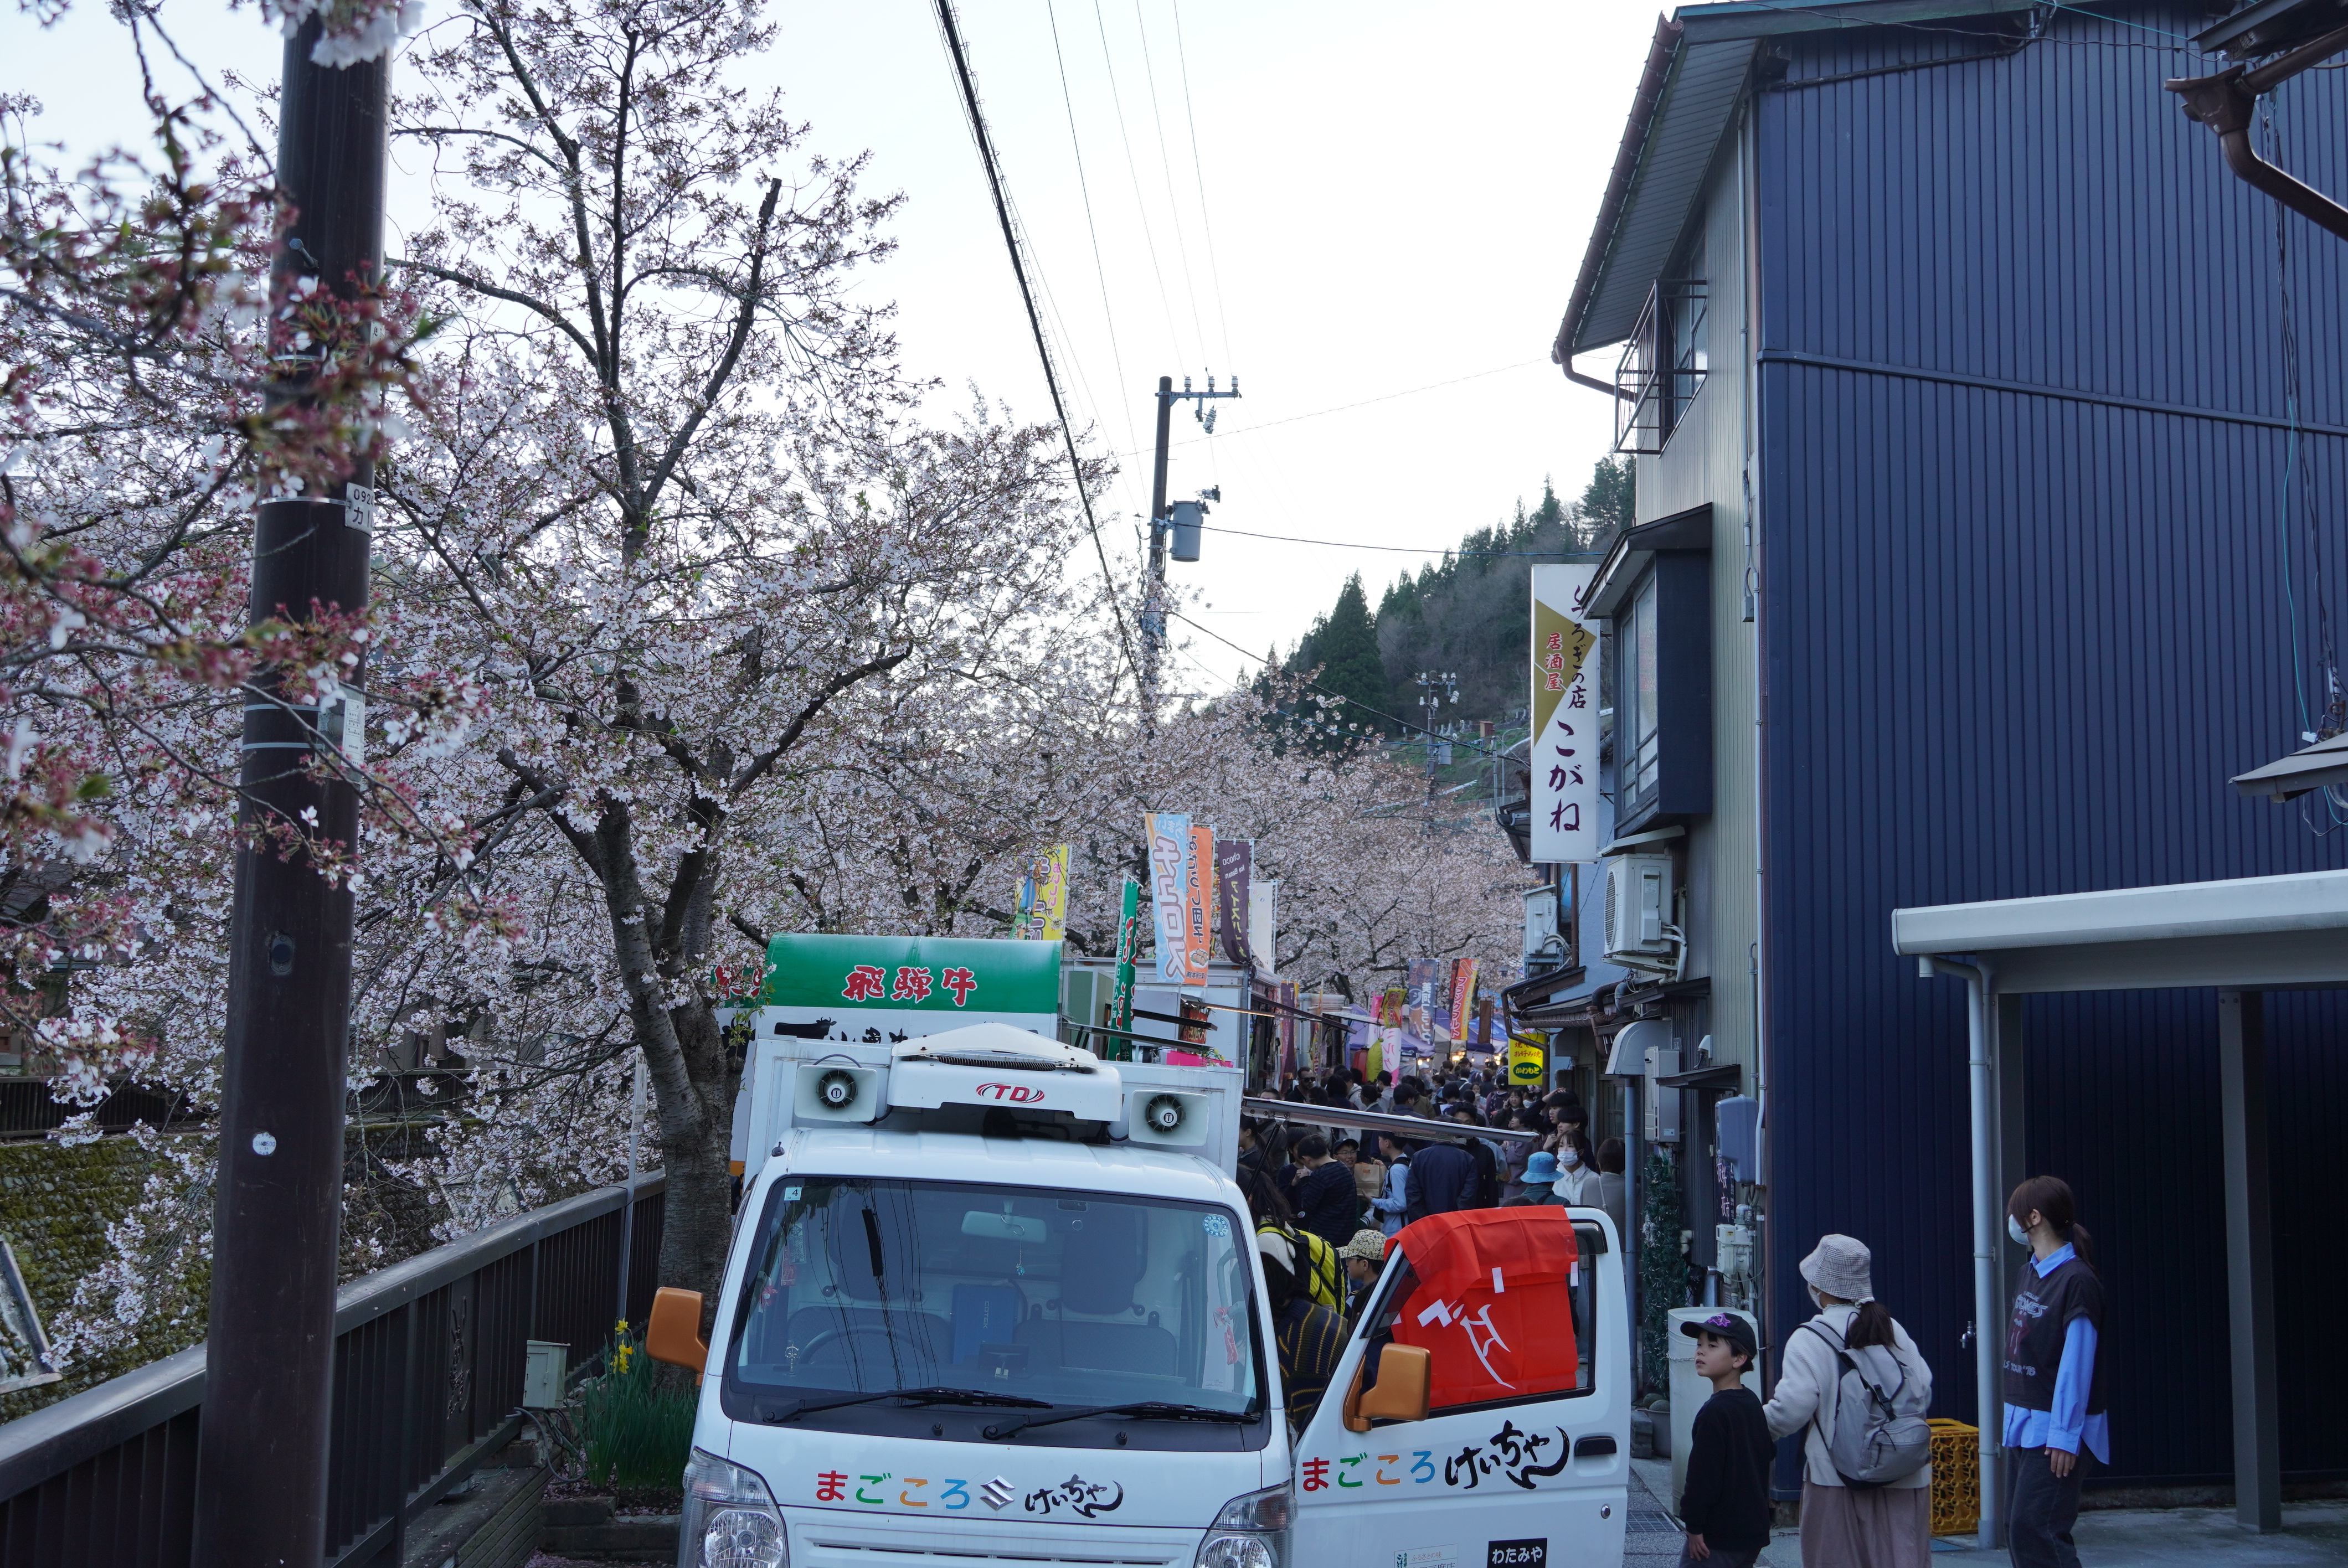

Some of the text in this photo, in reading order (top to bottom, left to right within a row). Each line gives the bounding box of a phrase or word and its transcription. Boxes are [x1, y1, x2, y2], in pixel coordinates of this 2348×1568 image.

[1544, 632, 1564, 692] 居酒屋
[1549, 720, 1584, 833] こがね
[842, 964, 978, 1007] 飛騨牛
[1450, 977, 1468, 1038] フランクフルト
[995, 1085, 1029, 1101] TD
[2015, 1294, 2048, 1318] STONES
[1302, 1420, 1570, 1492] まごころ けいちゃん
[815, 1469, 1124, 1518] まごころ けいちゃん
[1412, 1551, 1442, 1561] ふるさとの味
[1492, 1546, 1543, 1564] わたみや
